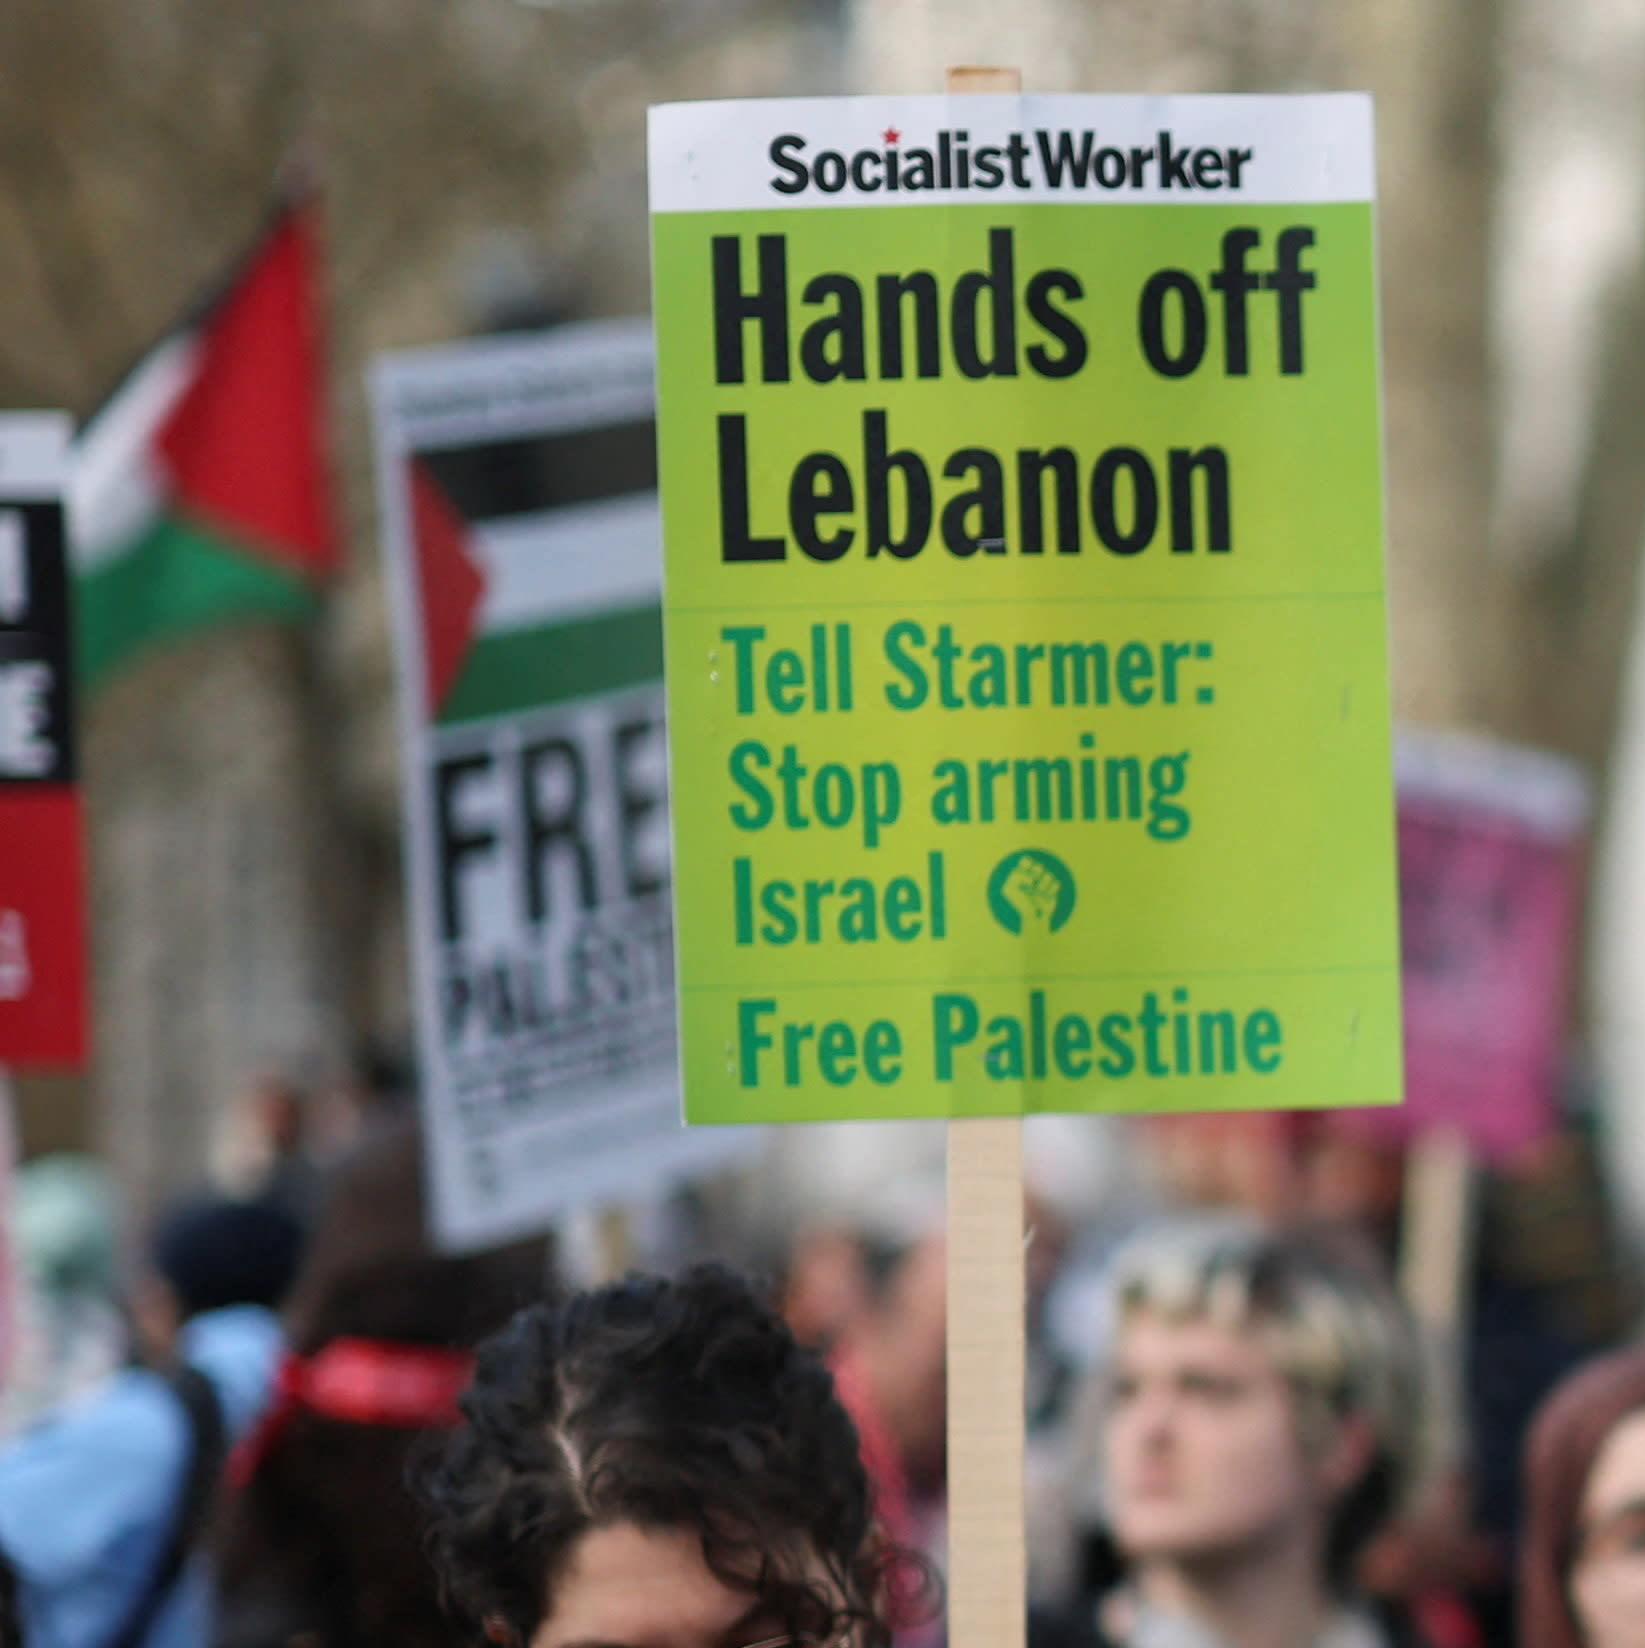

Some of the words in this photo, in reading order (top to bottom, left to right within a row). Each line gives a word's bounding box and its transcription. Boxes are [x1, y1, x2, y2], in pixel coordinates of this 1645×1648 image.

[769, 128, 1030, 194] Socialist
[1036, 130, 1253, 190] Worker
[711, 226, 1089, 385] Hands
[1137, 226, 1318, 379] off
[716, 409, 1233, 564] Lebanon
[721, 622, 853, 715] Tell
[882, 620, 1214, 711] Starmer:
[431, 722, 670, 942] FRE
[727, 739, 902, 849] Stop
[930, 732, 1192, 842] arming
[732, 850, 947, 947] Israel
[737, 998, 903, 1088] Free
[932, 987, 1284, 1083] Palestine
